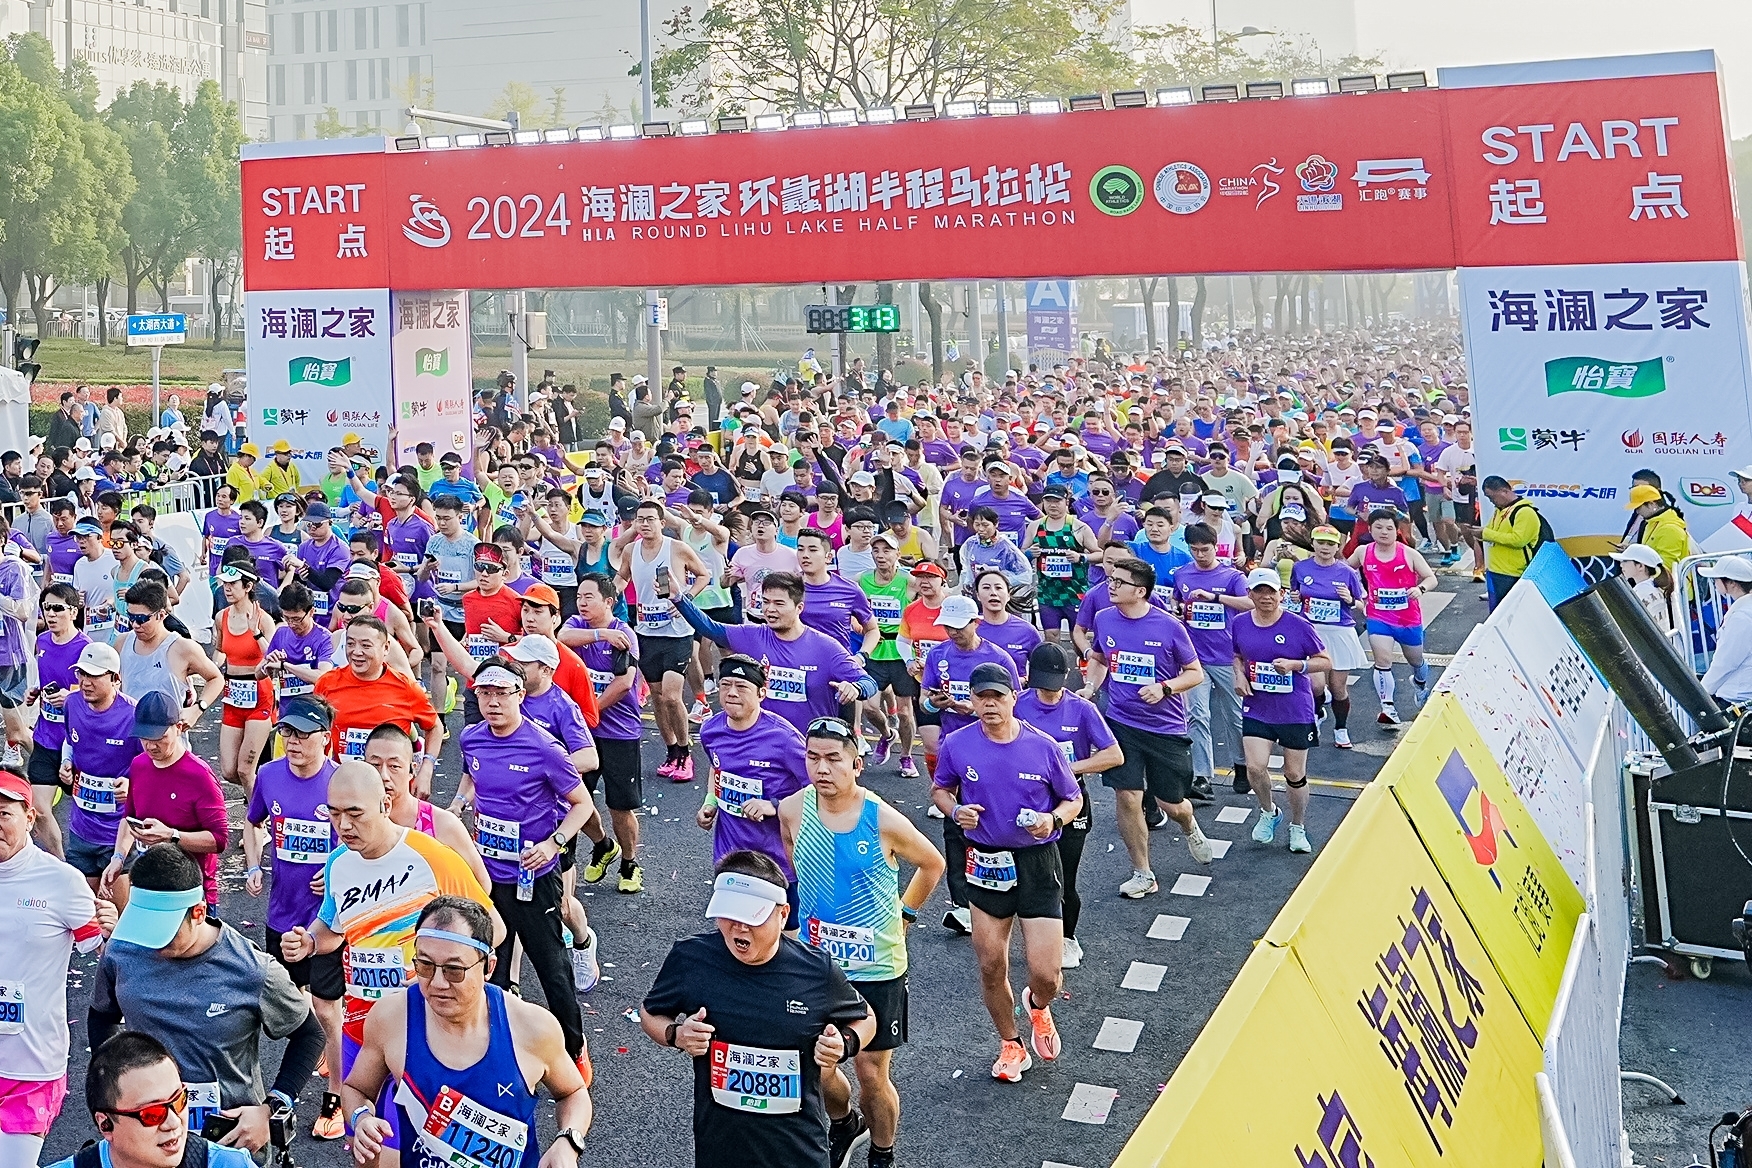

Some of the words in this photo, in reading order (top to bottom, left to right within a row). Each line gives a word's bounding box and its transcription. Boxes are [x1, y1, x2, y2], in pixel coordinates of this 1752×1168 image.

[1480, 117, 1679, 165] START
[1218, 176, 1258, 188] CHINA
[261, 183, 366, 217] START
[466, 192, 572, 240] 2024
[582, 226, 616, 242] HLA
[632, 224, 708, 241] ROUND
[720, 220, 773, 237] LIHU
[786, 217, 845, 234] LAKE
[858, 215, 919, 232] HALF
[934, 209, 1076, 229] MARATHON
[1030, 281, 1068, 307] A
[398, 298, 461, 330] 海澜之家
[1487, 286, 1711, 332] 海澜之家
[138, 317, 175, 331] 太湖西大道
[261, 306, 376, 339] 海澜之家
[1571, 364, 1639, 390] 怡寶
[1531, 428, 1587, 452] 蒙牛
[1652, 431, 1728, 447] 国联人寿
[1703, 448, 1725, 456] LIFE
[1689, 482, 1727, 497] Dole
[1192, 611, 1223, 622] 15524
[1118, 662, 1152, 677] 16274
[769, 679, 802, 694] 22192
[1257, 673, 1290, 686] 16096
[340, 731, 346, 740] B
[276, 823, 283, 831] B
[284, 822, 317, 834] 海澜之家
[284, 835, 329, 854] 14645
[820, 925, 858, 940] 海澜之家
[351, 952, 386, 965] 海澜之家
[352, 967, 400, 988] 20160
[209, 1003, 227, 1012] NIKE
[1357, 885, 1486, 1158] 海澜之家
[714, 1048, 724, 1063] B
[728, 1050, 780, 1069] 海澜之家
[728, 1069, 791, 1098] 20881
[439, 1096, 452, 1113] B
[456, 1094, 512, 1139] 海澜之家
